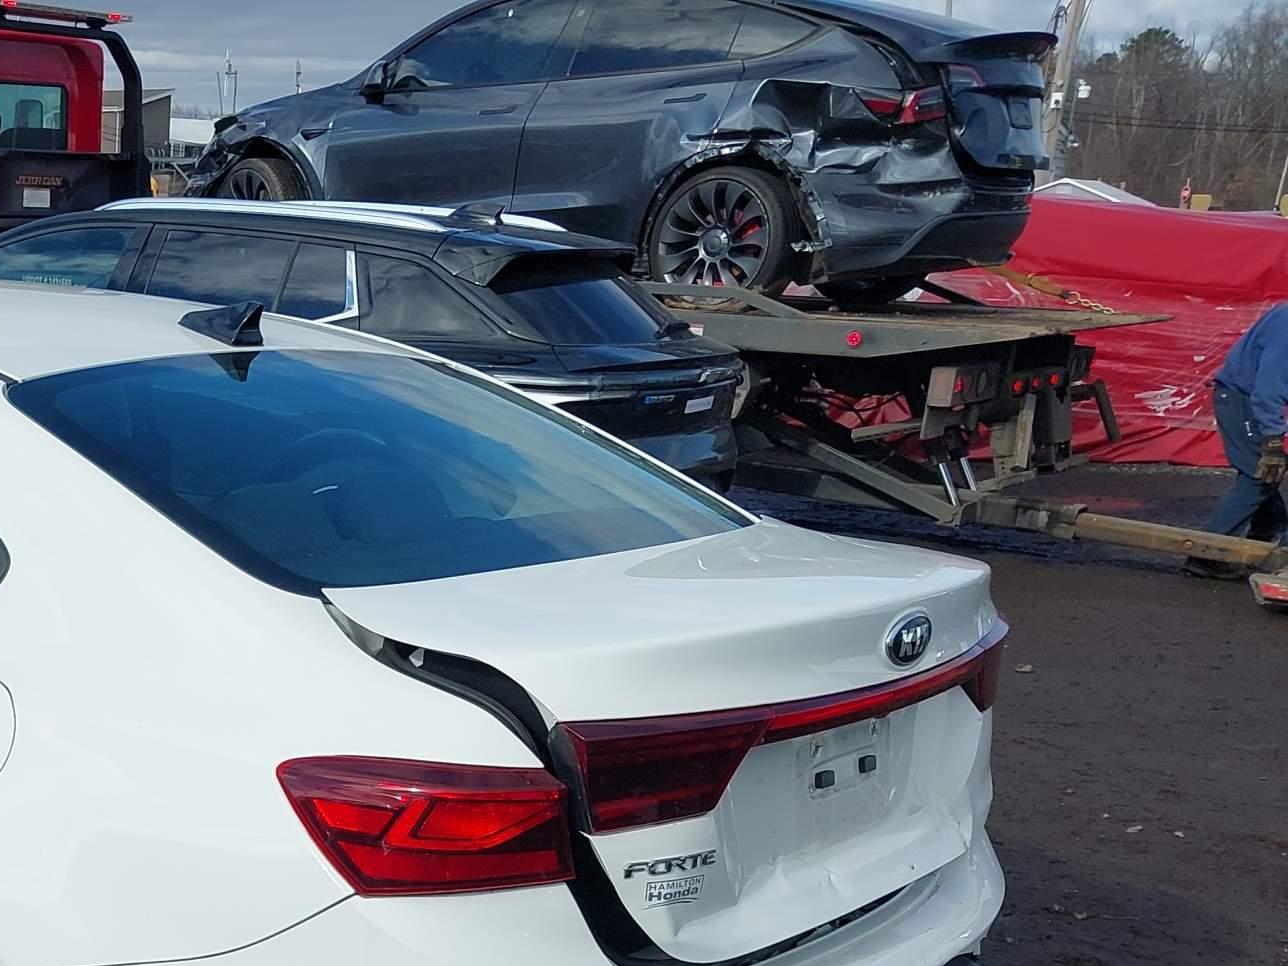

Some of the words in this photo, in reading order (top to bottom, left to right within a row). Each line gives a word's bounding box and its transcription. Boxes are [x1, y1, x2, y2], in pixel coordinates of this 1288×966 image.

[898, 623, 929, 658] KIA
[623, 848, 717, 880] FORTE
[647, 886, 699, 902] Honda
[648, 877, 702, 892] HAMILTON
